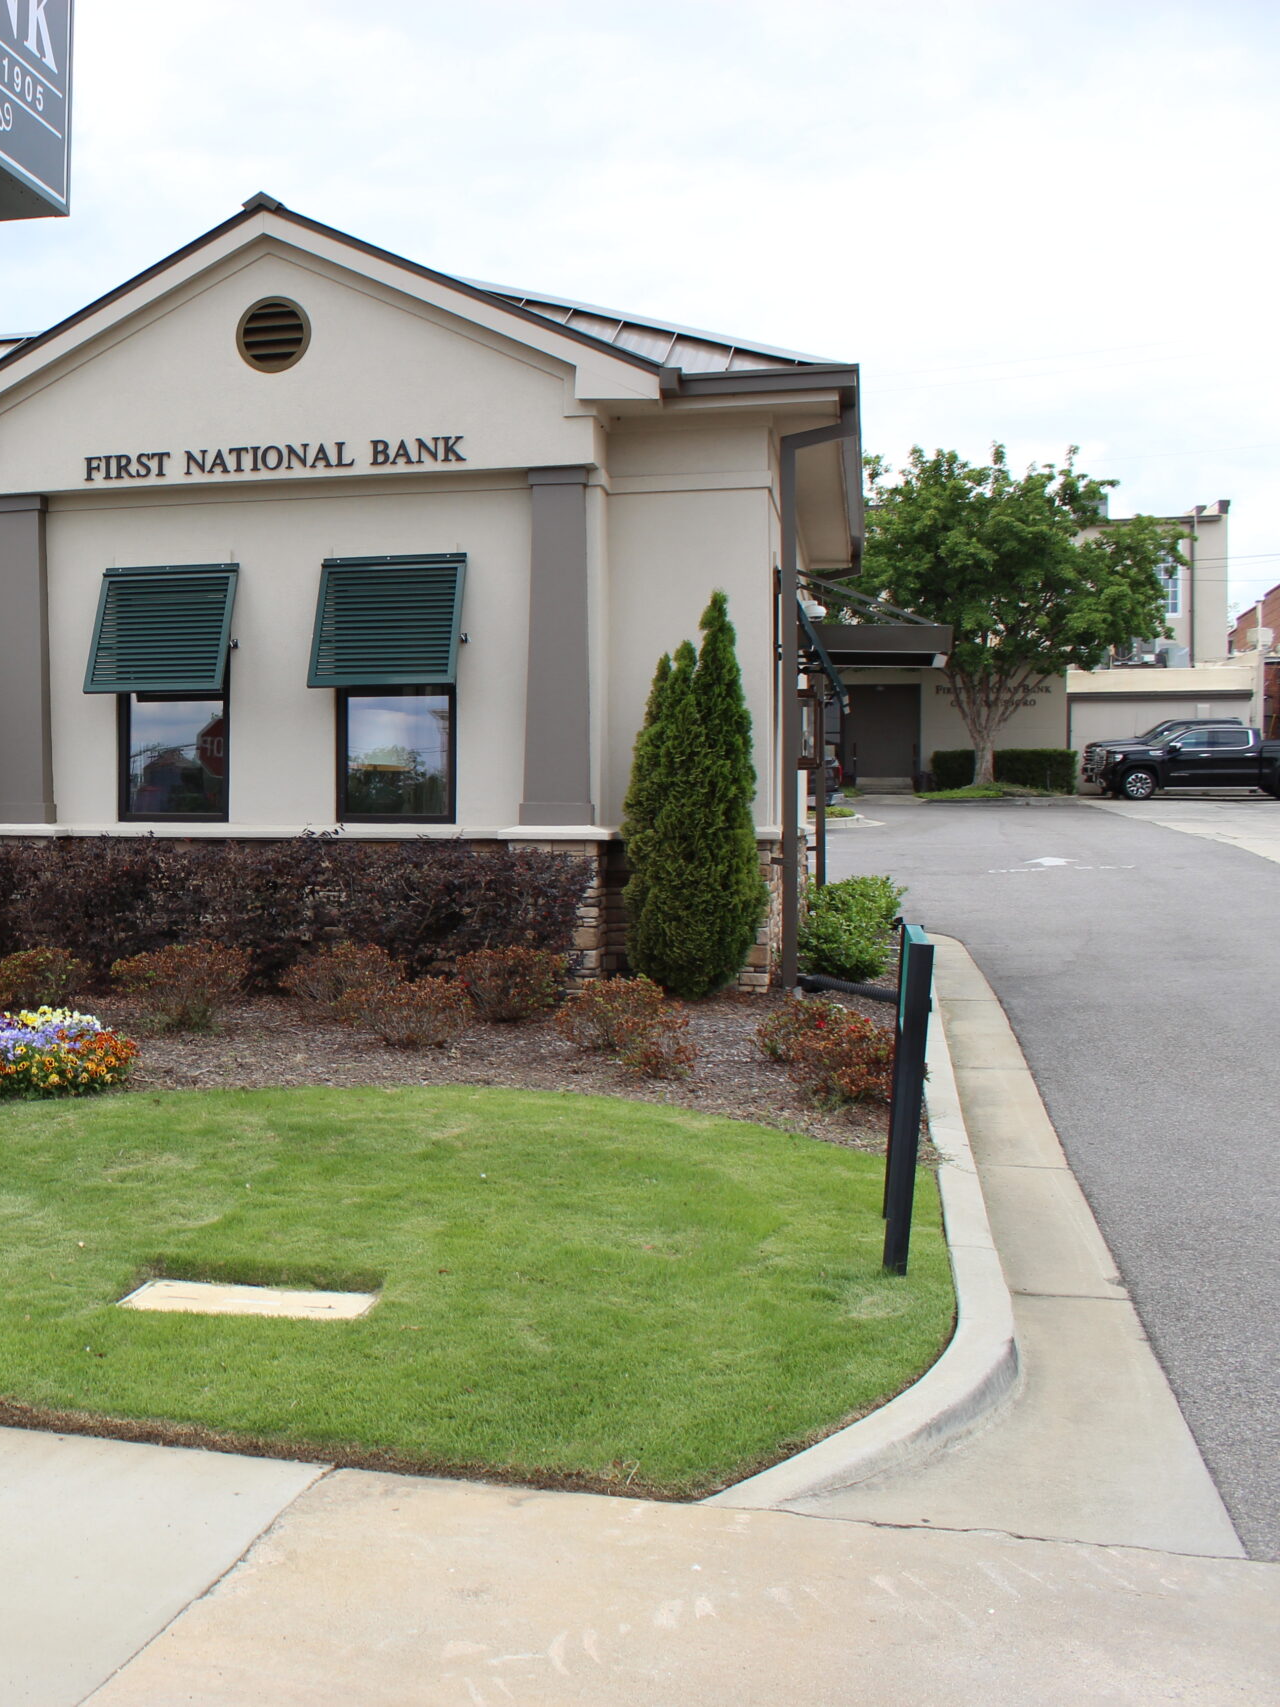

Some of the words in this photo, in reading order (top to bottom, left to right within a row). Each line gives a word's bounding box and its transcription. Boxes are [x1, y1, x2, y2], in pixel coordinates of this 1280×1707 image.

[2, 57, 44, 112] 1905
[84, 452, 171, 482] FIRST
[184, 441, 355, 475] NATIONAL
[370, 435, 467, 466] BANK
